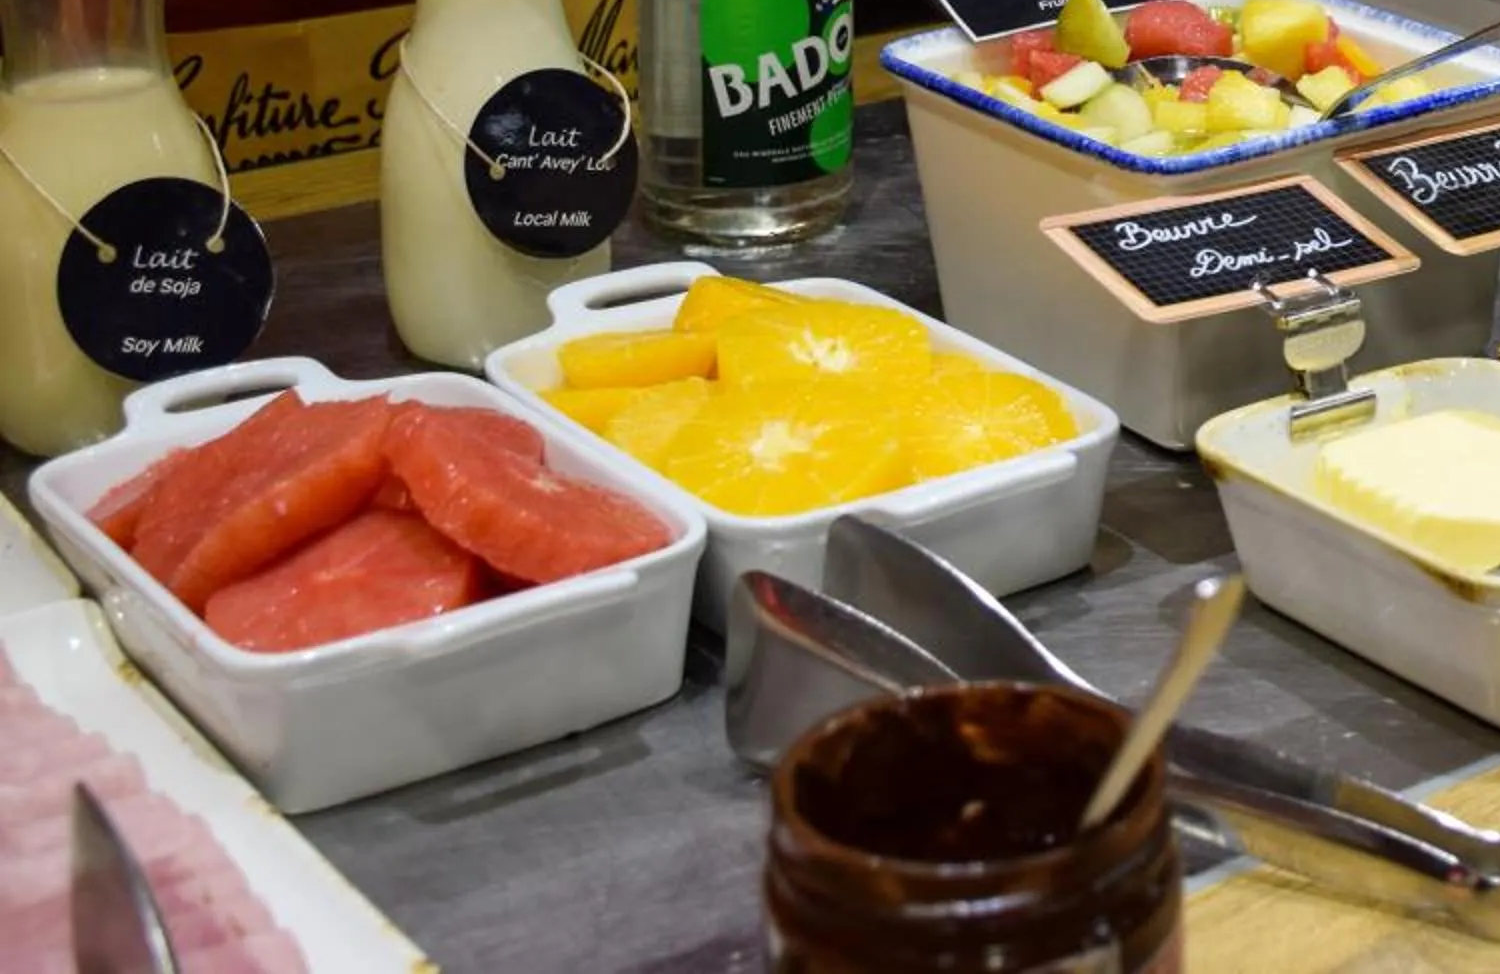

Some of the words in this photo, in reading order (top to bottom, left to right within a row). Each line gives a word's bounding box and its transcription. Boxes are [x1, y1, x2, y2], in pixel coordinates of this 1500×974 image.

[768, 94, 826, 136] FINEMENT
[528, 125, 582, 148] Lait
[540, 154, 585, 175] Avey'
[513, 210, 559, 227] Local
[559, 210, 593, 227] Milk
[1115, 212, 1257, 251] Beurre
[132, 244, 200, 270] Lait
[129, 275, 155, 294] de
[159, 277, 202, 300] Soja
[121, 336, 160, 358] Soy
[163, 336, 204, 353] Milk
